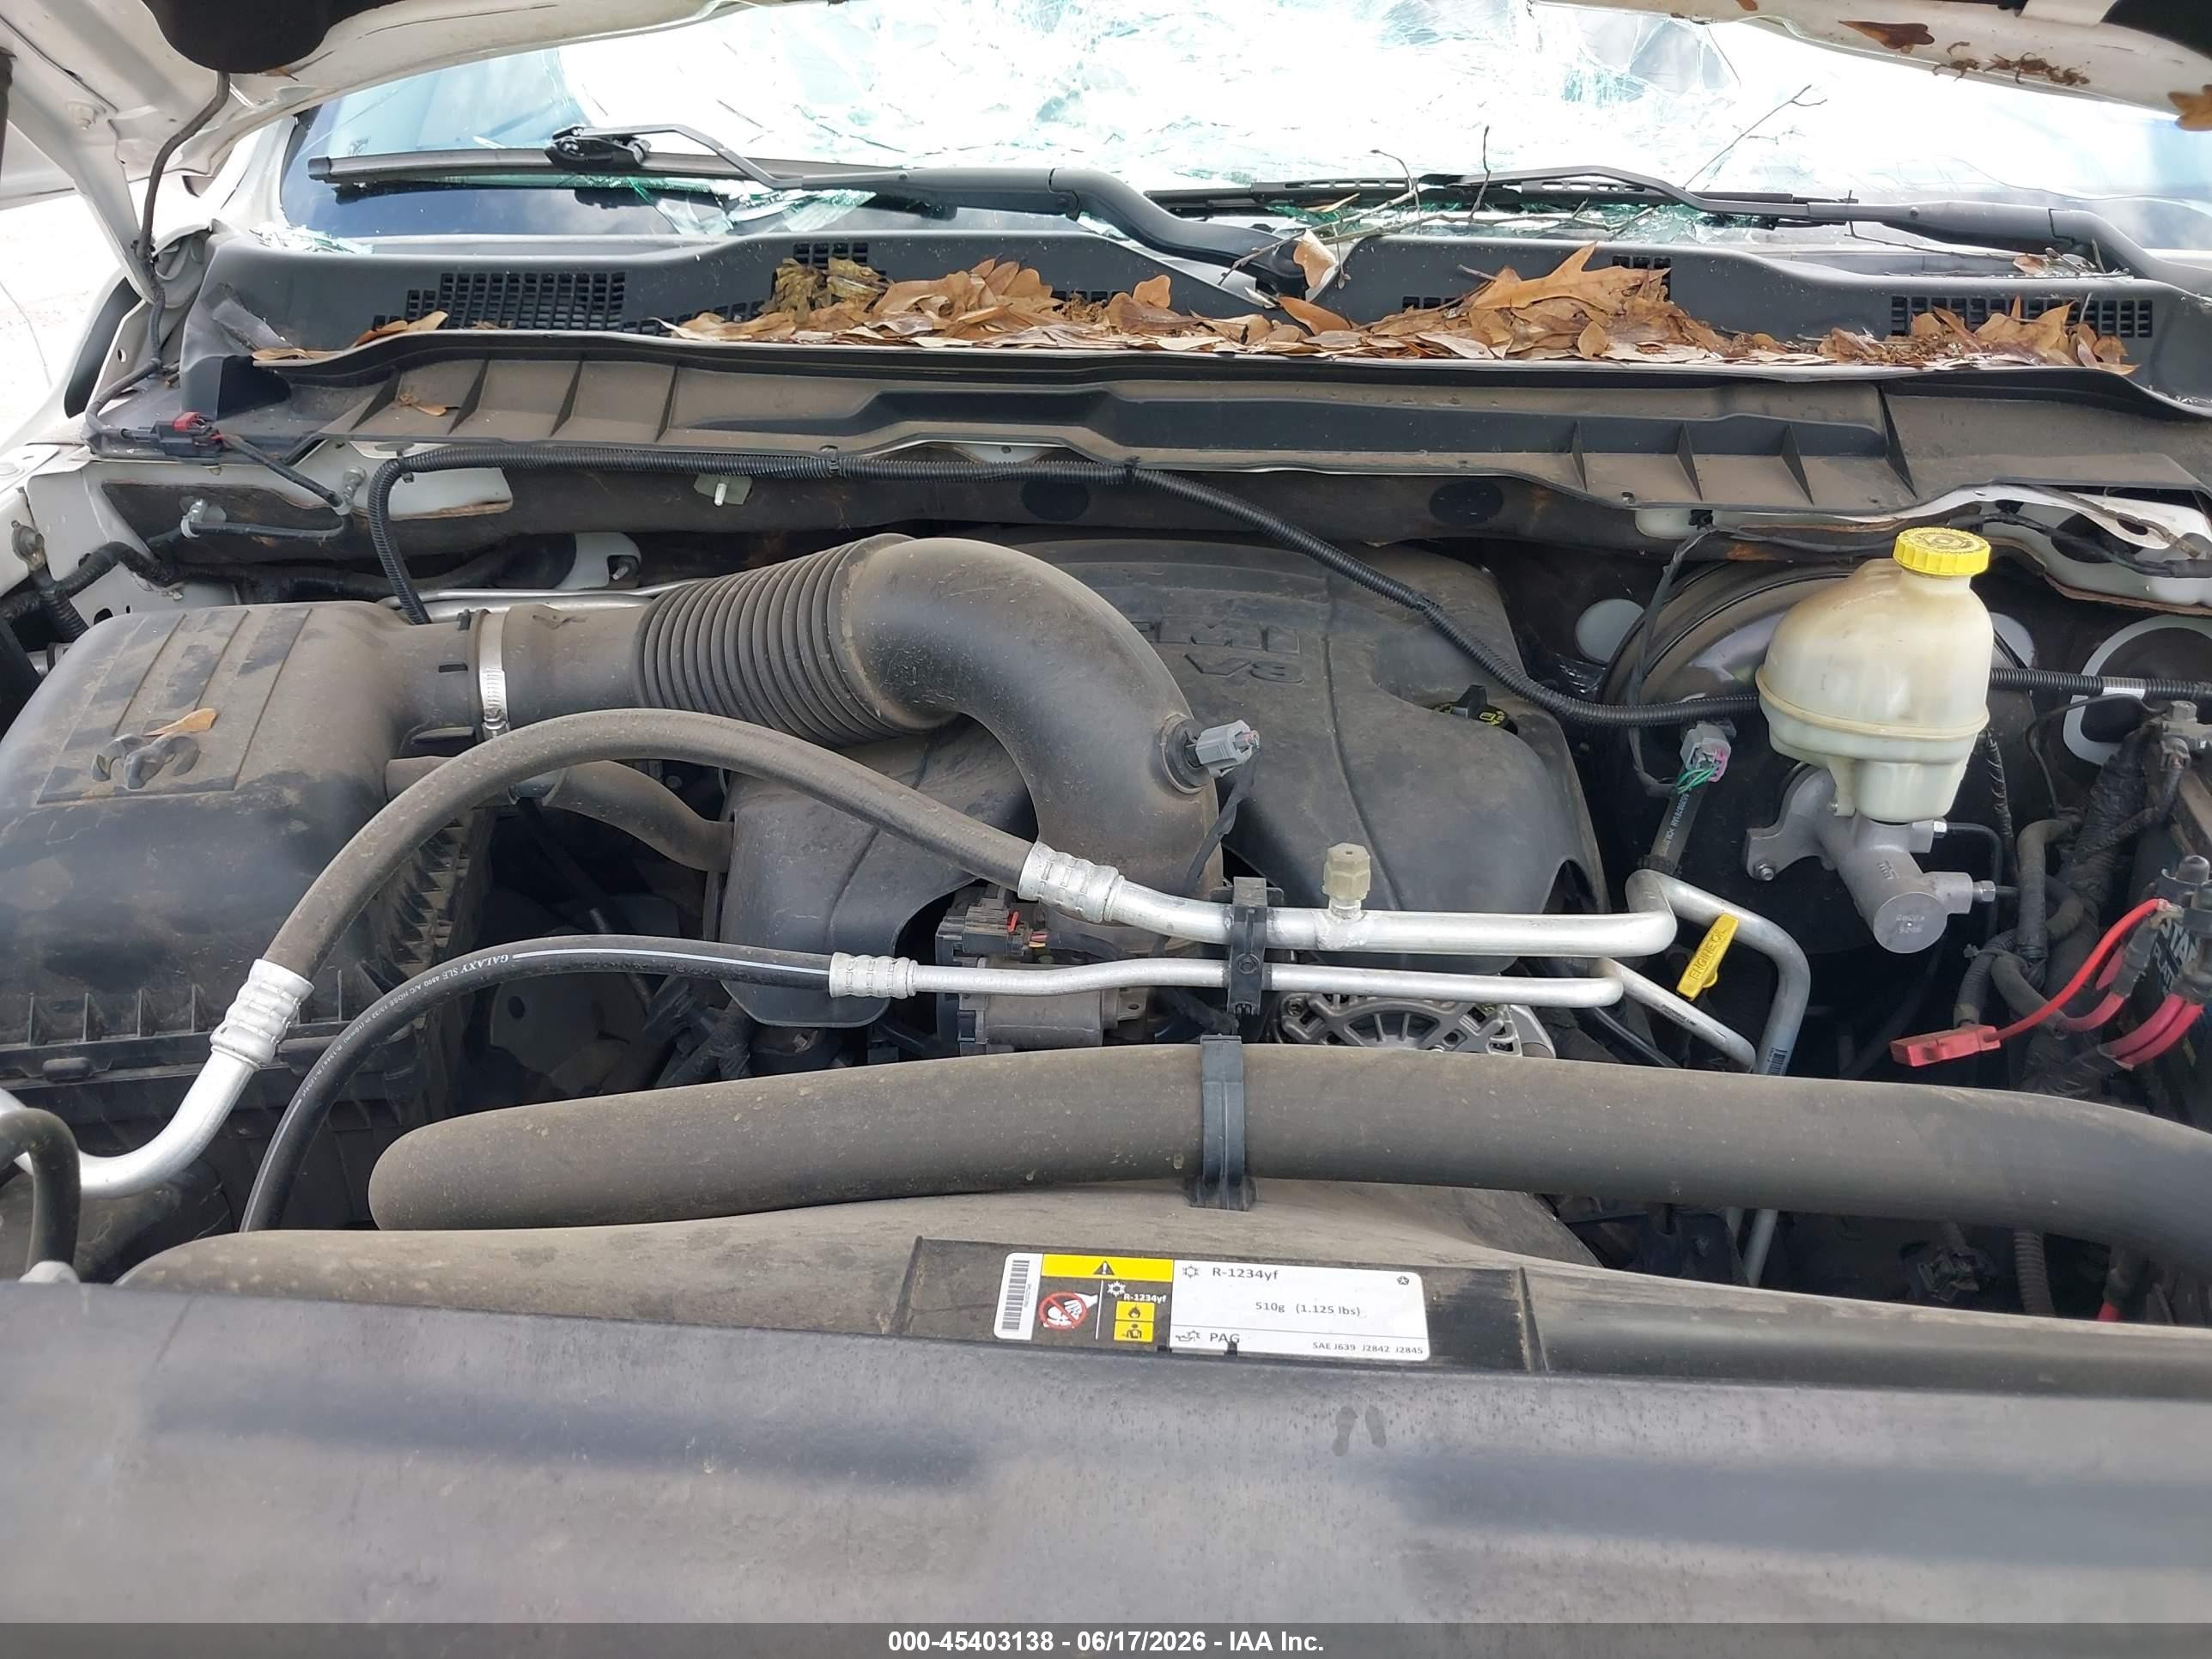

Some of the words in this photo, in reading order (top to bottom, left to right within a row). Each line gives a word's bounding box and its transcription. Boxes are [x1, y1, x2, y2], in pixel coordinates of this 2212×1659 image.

[1183, 653, 1304, 684] V8
[460, 953, 509, 975] GALAXY
[1688, 940, 1717, 981] ENGINE
[442, 968, 459, 980] SLE
[410, 983, 422, 995] A/C
[390, 992, 410, 1007] HOSE
[343, 1022, 365, 1044] (10mm)
[1212, 1267, 1279, 1281] R-1234yf
[1122, 1292, 1168, 1304] R-1234yf
[1255, 1301, 1285, 1313] 510g
[1295, 1303, 1335, 1315] (1.125
[1338, 1304, 1362, 1317] lbs)
[1208, 1331, 1241, 1344] PAG
[1312, 1341, 1332, 1351] SAE
[1334, 1342, 1357, 1352] J639
[1361, 1345, 1390, 1353] J2842
[1395, 1346, 1424, 1355] J2845
